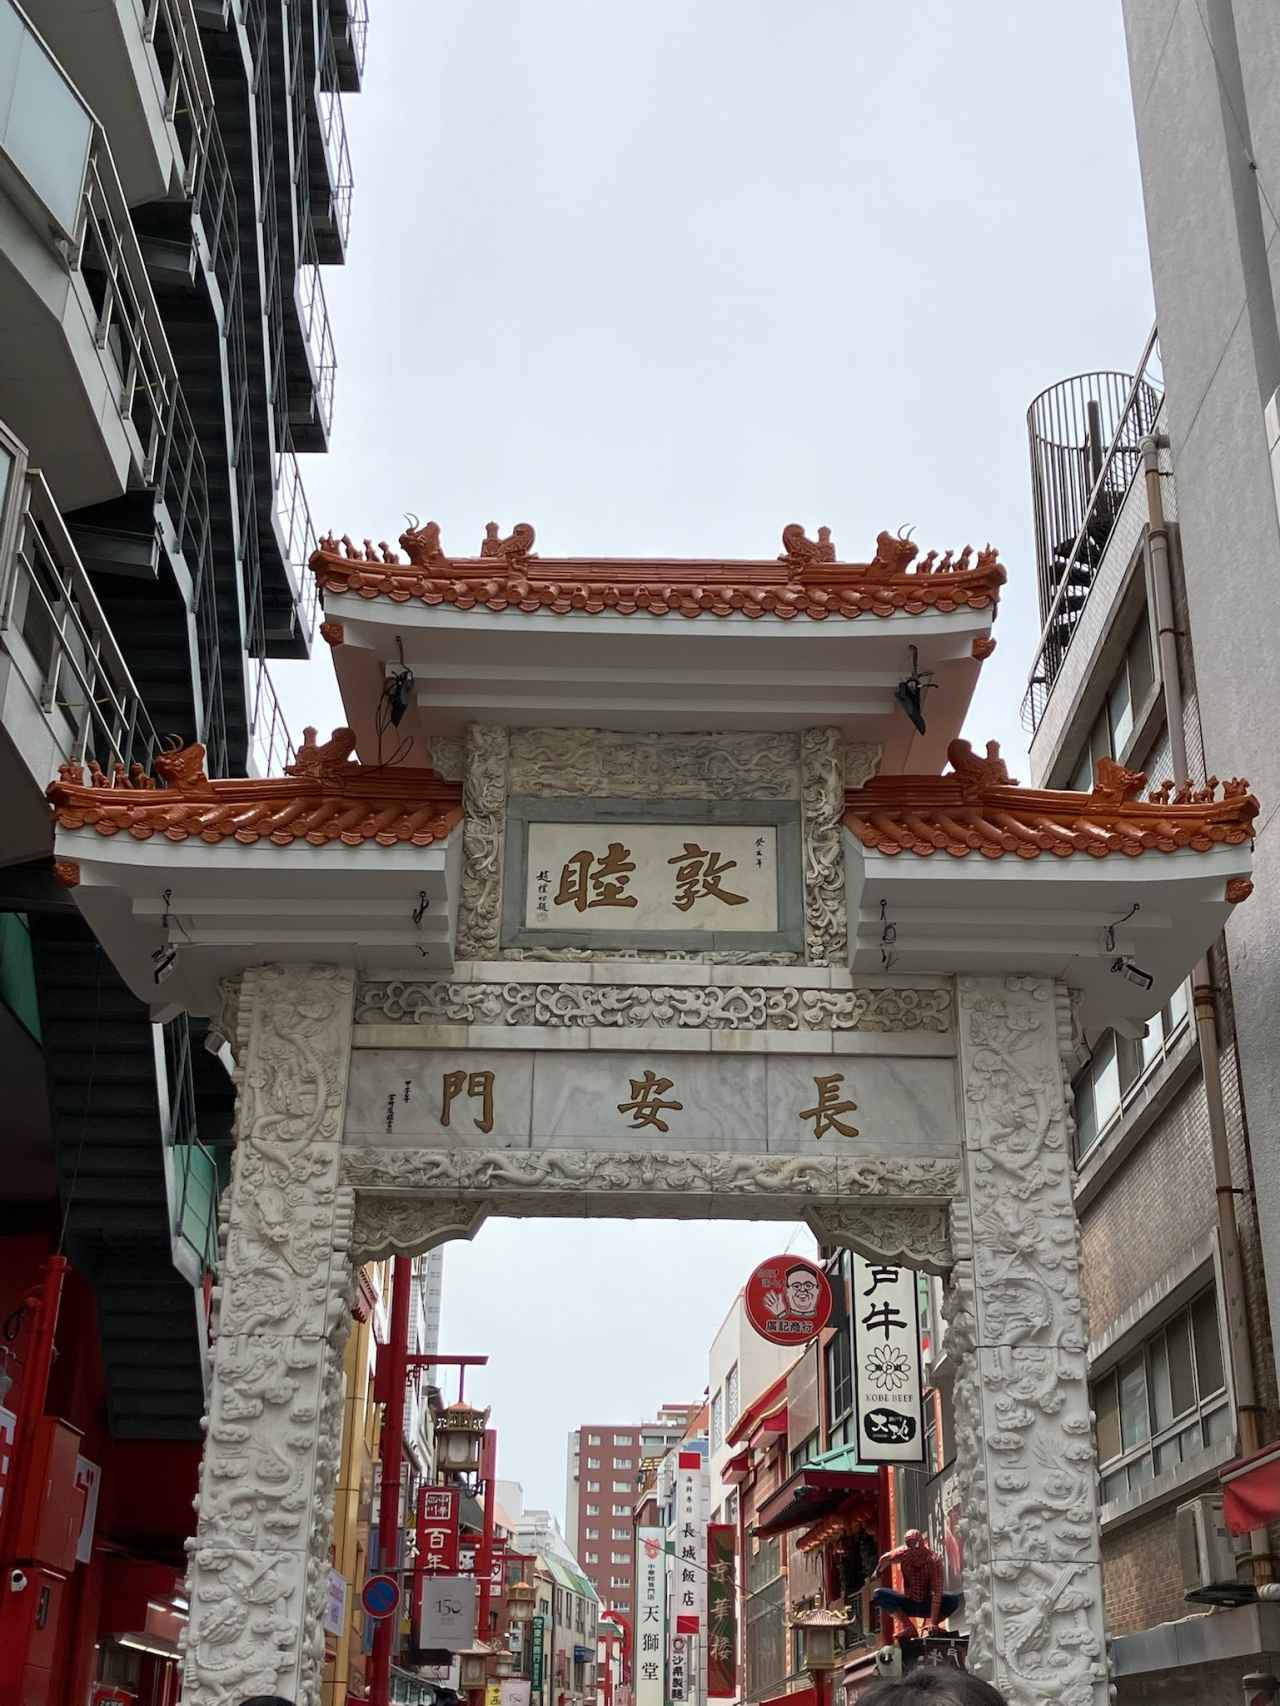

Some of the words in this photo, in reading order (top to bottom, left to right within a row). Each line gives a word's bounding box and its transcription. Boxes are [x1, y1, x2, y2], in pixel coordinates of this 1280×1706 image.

[865, 1393, 889, 1403] KOBE
[892, 1393, 913, 1403] BEEF
[682, 1522, 697, 1605] 長城飯店
[641, 1605, 659, 1681] 天獅堂
